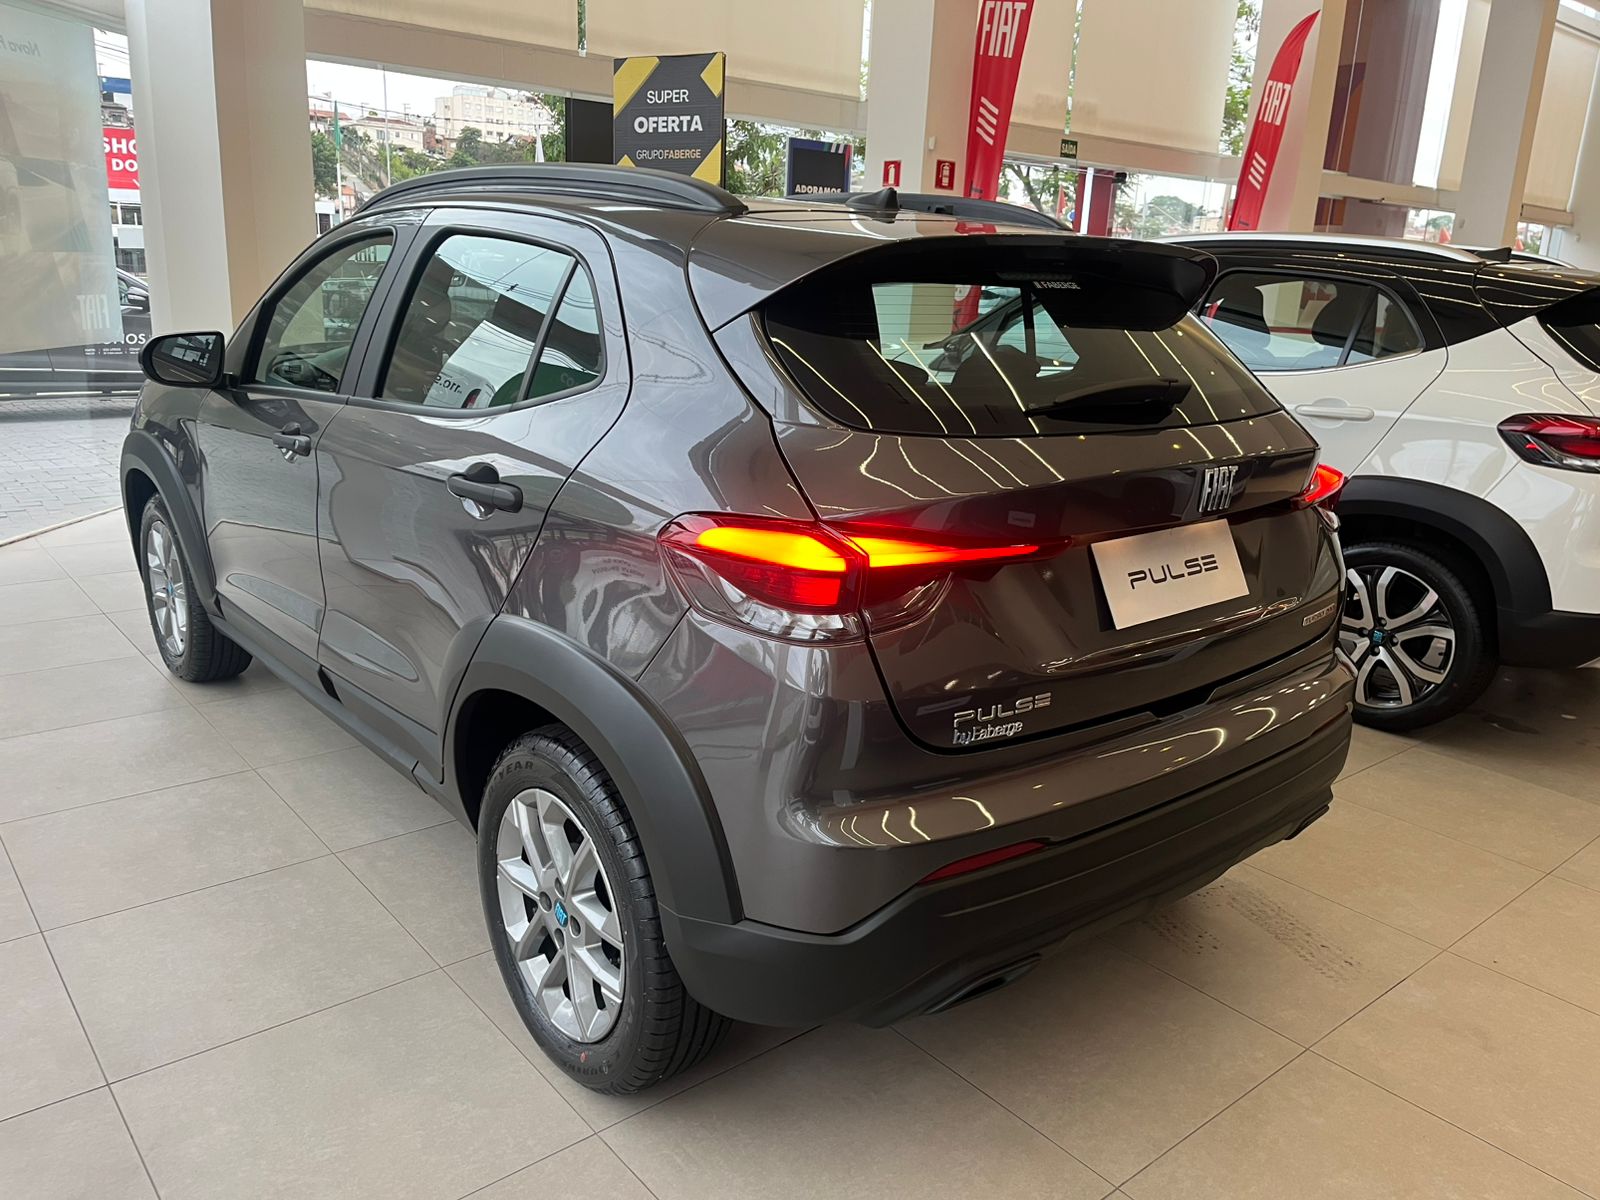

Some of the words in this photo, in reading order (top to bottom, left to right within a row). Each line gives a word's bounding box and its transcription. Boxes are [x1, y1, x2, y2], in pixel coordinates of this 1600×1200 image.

[980, 0, 1027, 58] FIAT
[646, 89, 689, 104] SUPER
[1259, 80, 1291, 126] FIAT
[633, 115, 703, 133] OFERTA
[1199, 465, 1239, 513] FIAT
[1127, 553, 1220, 590] PULSE
[953, 692, 1052, 728] PULSE
